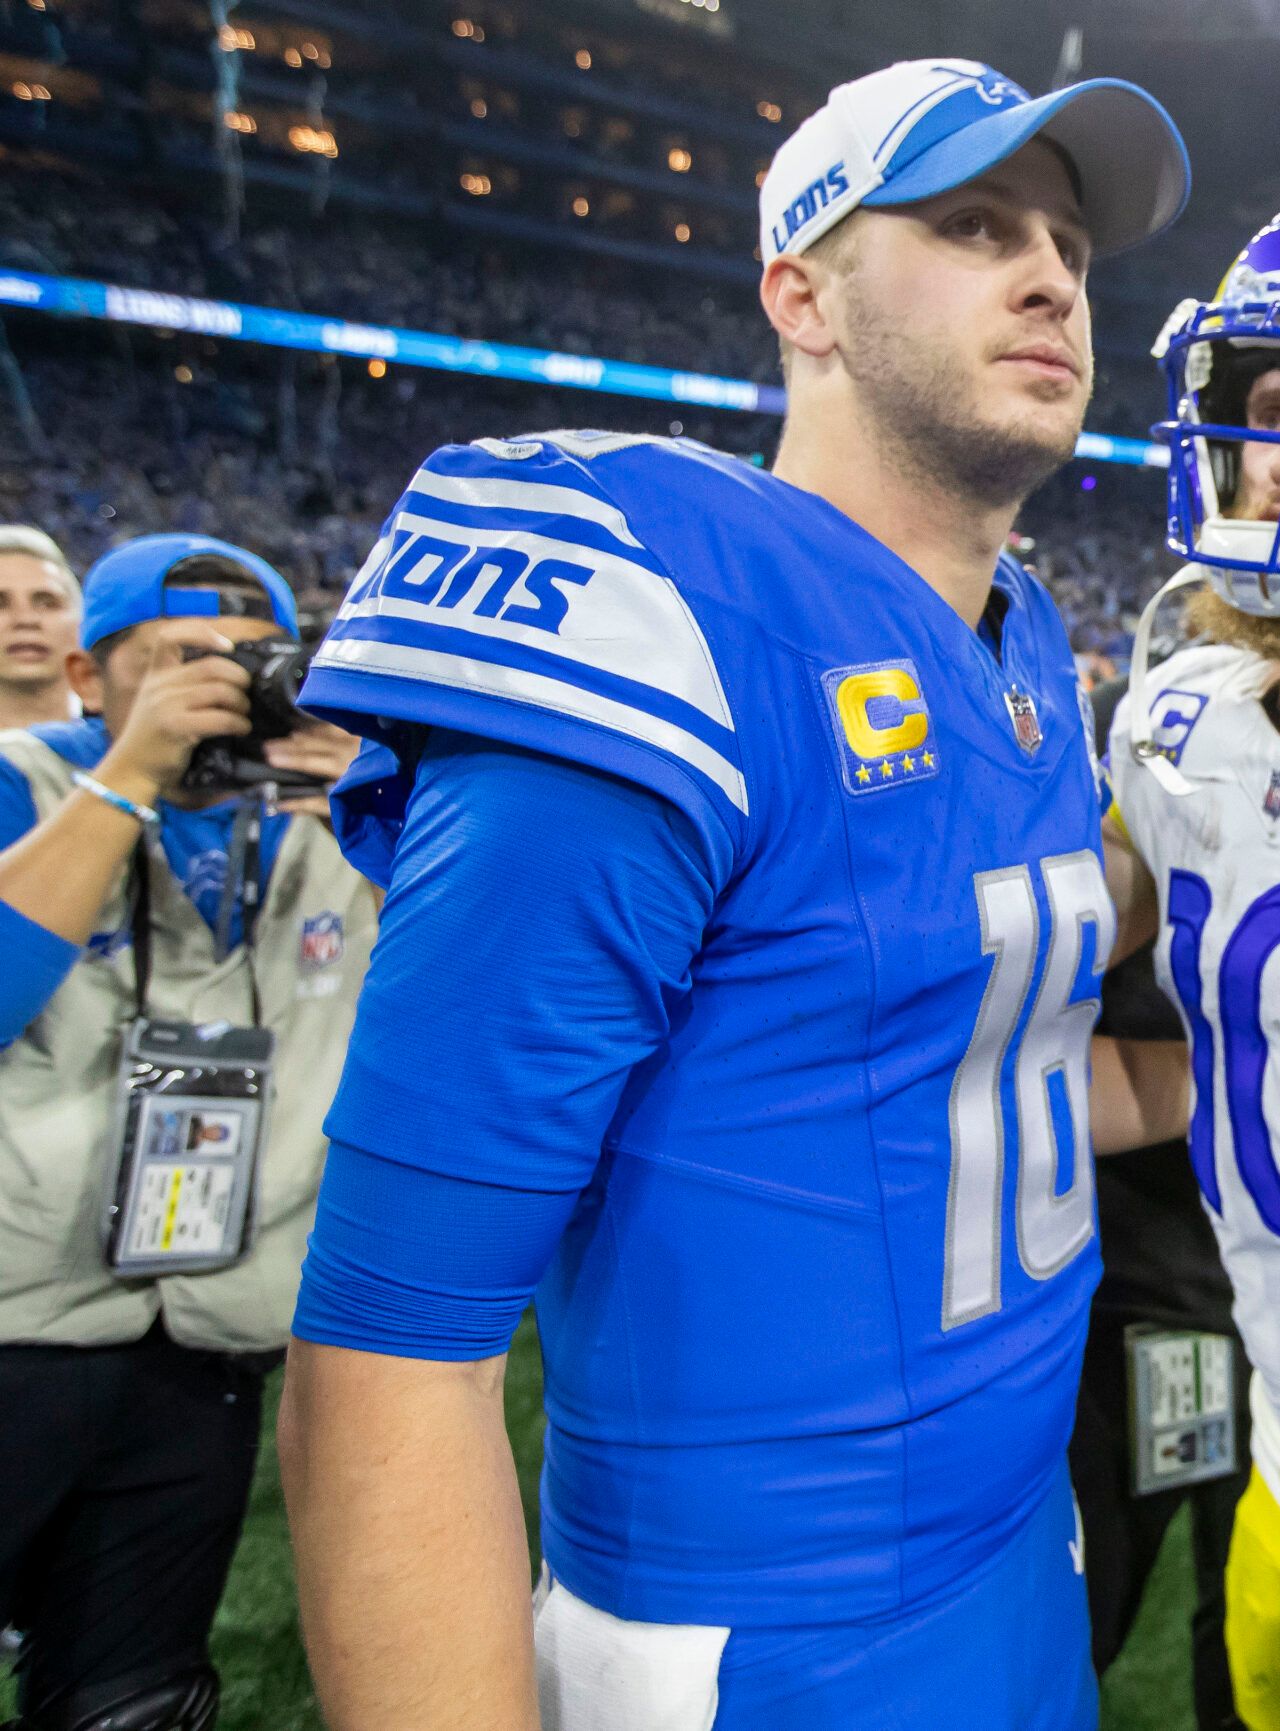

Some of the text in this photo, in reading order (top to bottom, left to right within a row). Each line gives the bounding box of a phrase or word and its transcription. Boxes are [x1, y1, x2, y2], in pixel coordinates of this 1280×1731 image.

[773, 160, 849, 253] LIONS
[836, 668, 929, 760] C
[942, 849, 1116, 1331] 16
